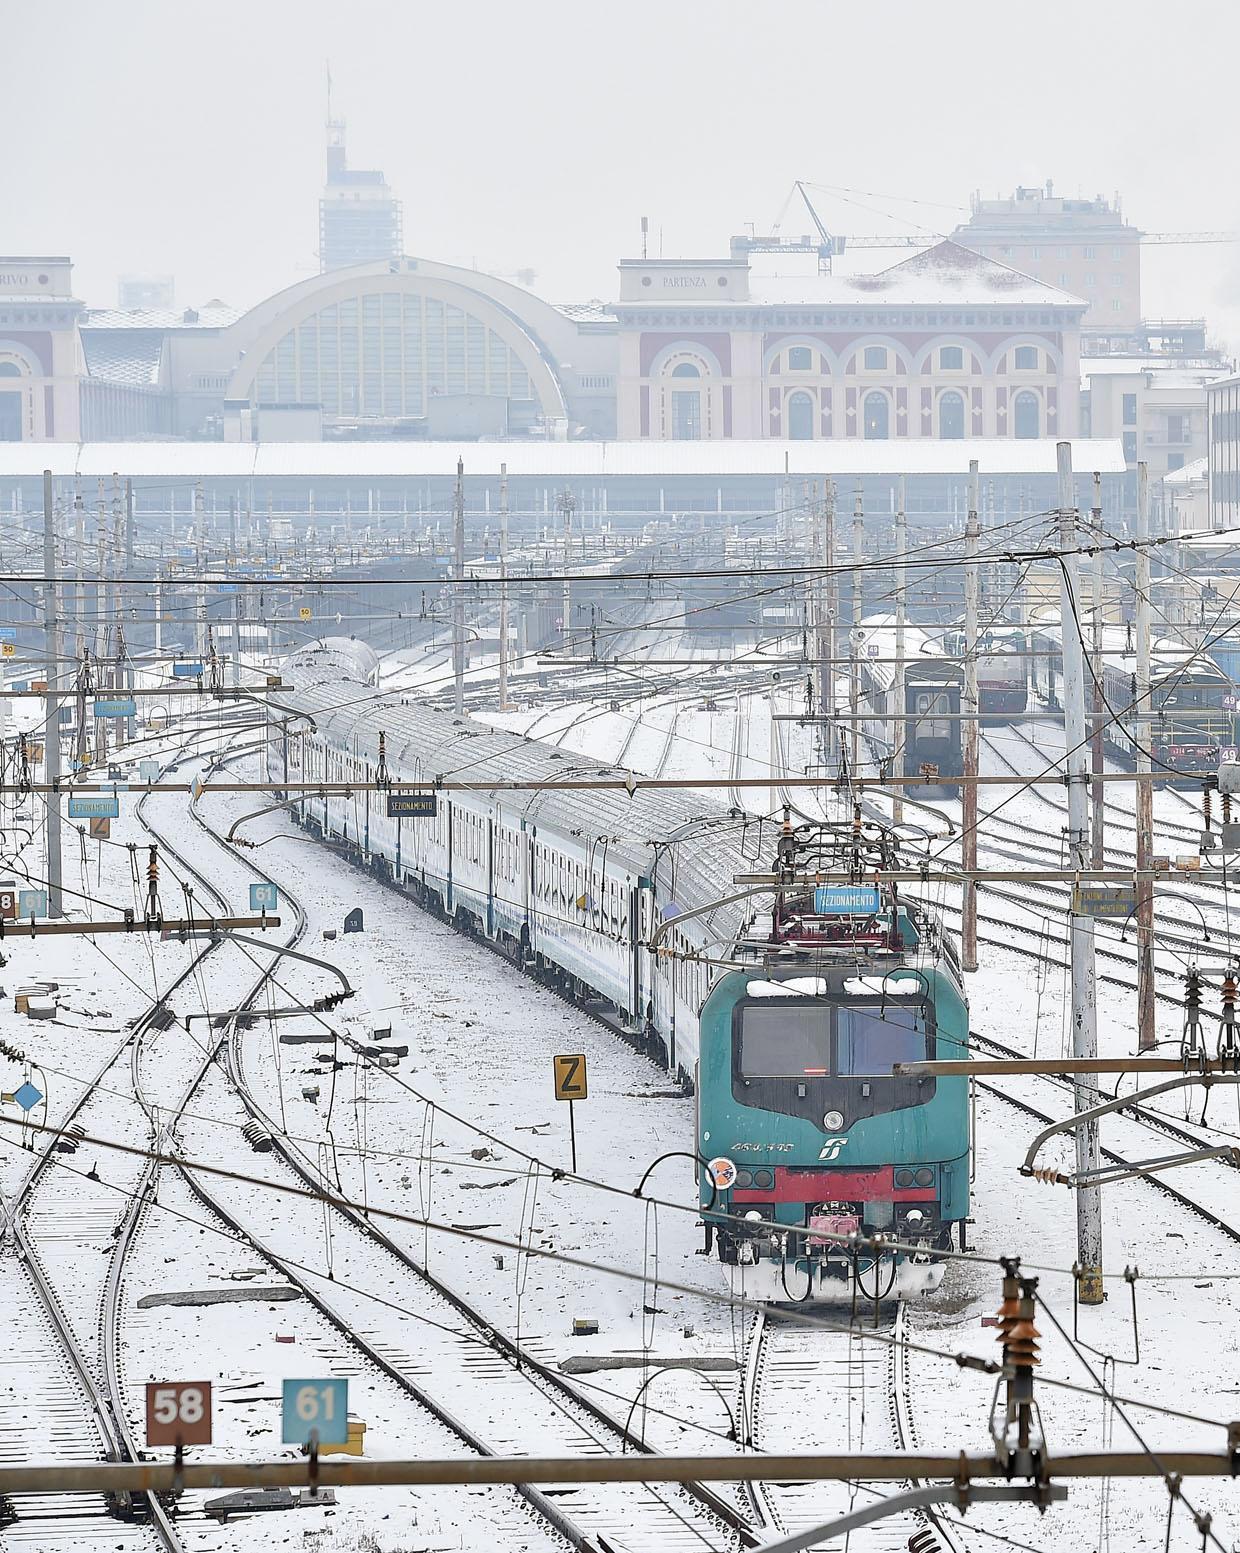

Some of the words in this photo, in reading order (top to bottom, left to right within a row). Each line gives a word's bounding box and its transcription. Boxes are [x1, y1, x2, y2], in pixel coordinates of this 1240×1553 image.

[663, 277, 706, 288] PARTENZA
[1224, 696, 1235, 704] 49
[1222, 750, 1236, 760] 49
[391, 801, 433, 811] SEZIONAMENTO
[256, 887, 272, 901] 61
[820, 895, 875, 907] SEZIONAMENTO
[560, 1058, 581, 1091] Z
[154, 1388, 205, 1424] 58
[296, 1386, 335, 1421] 61
